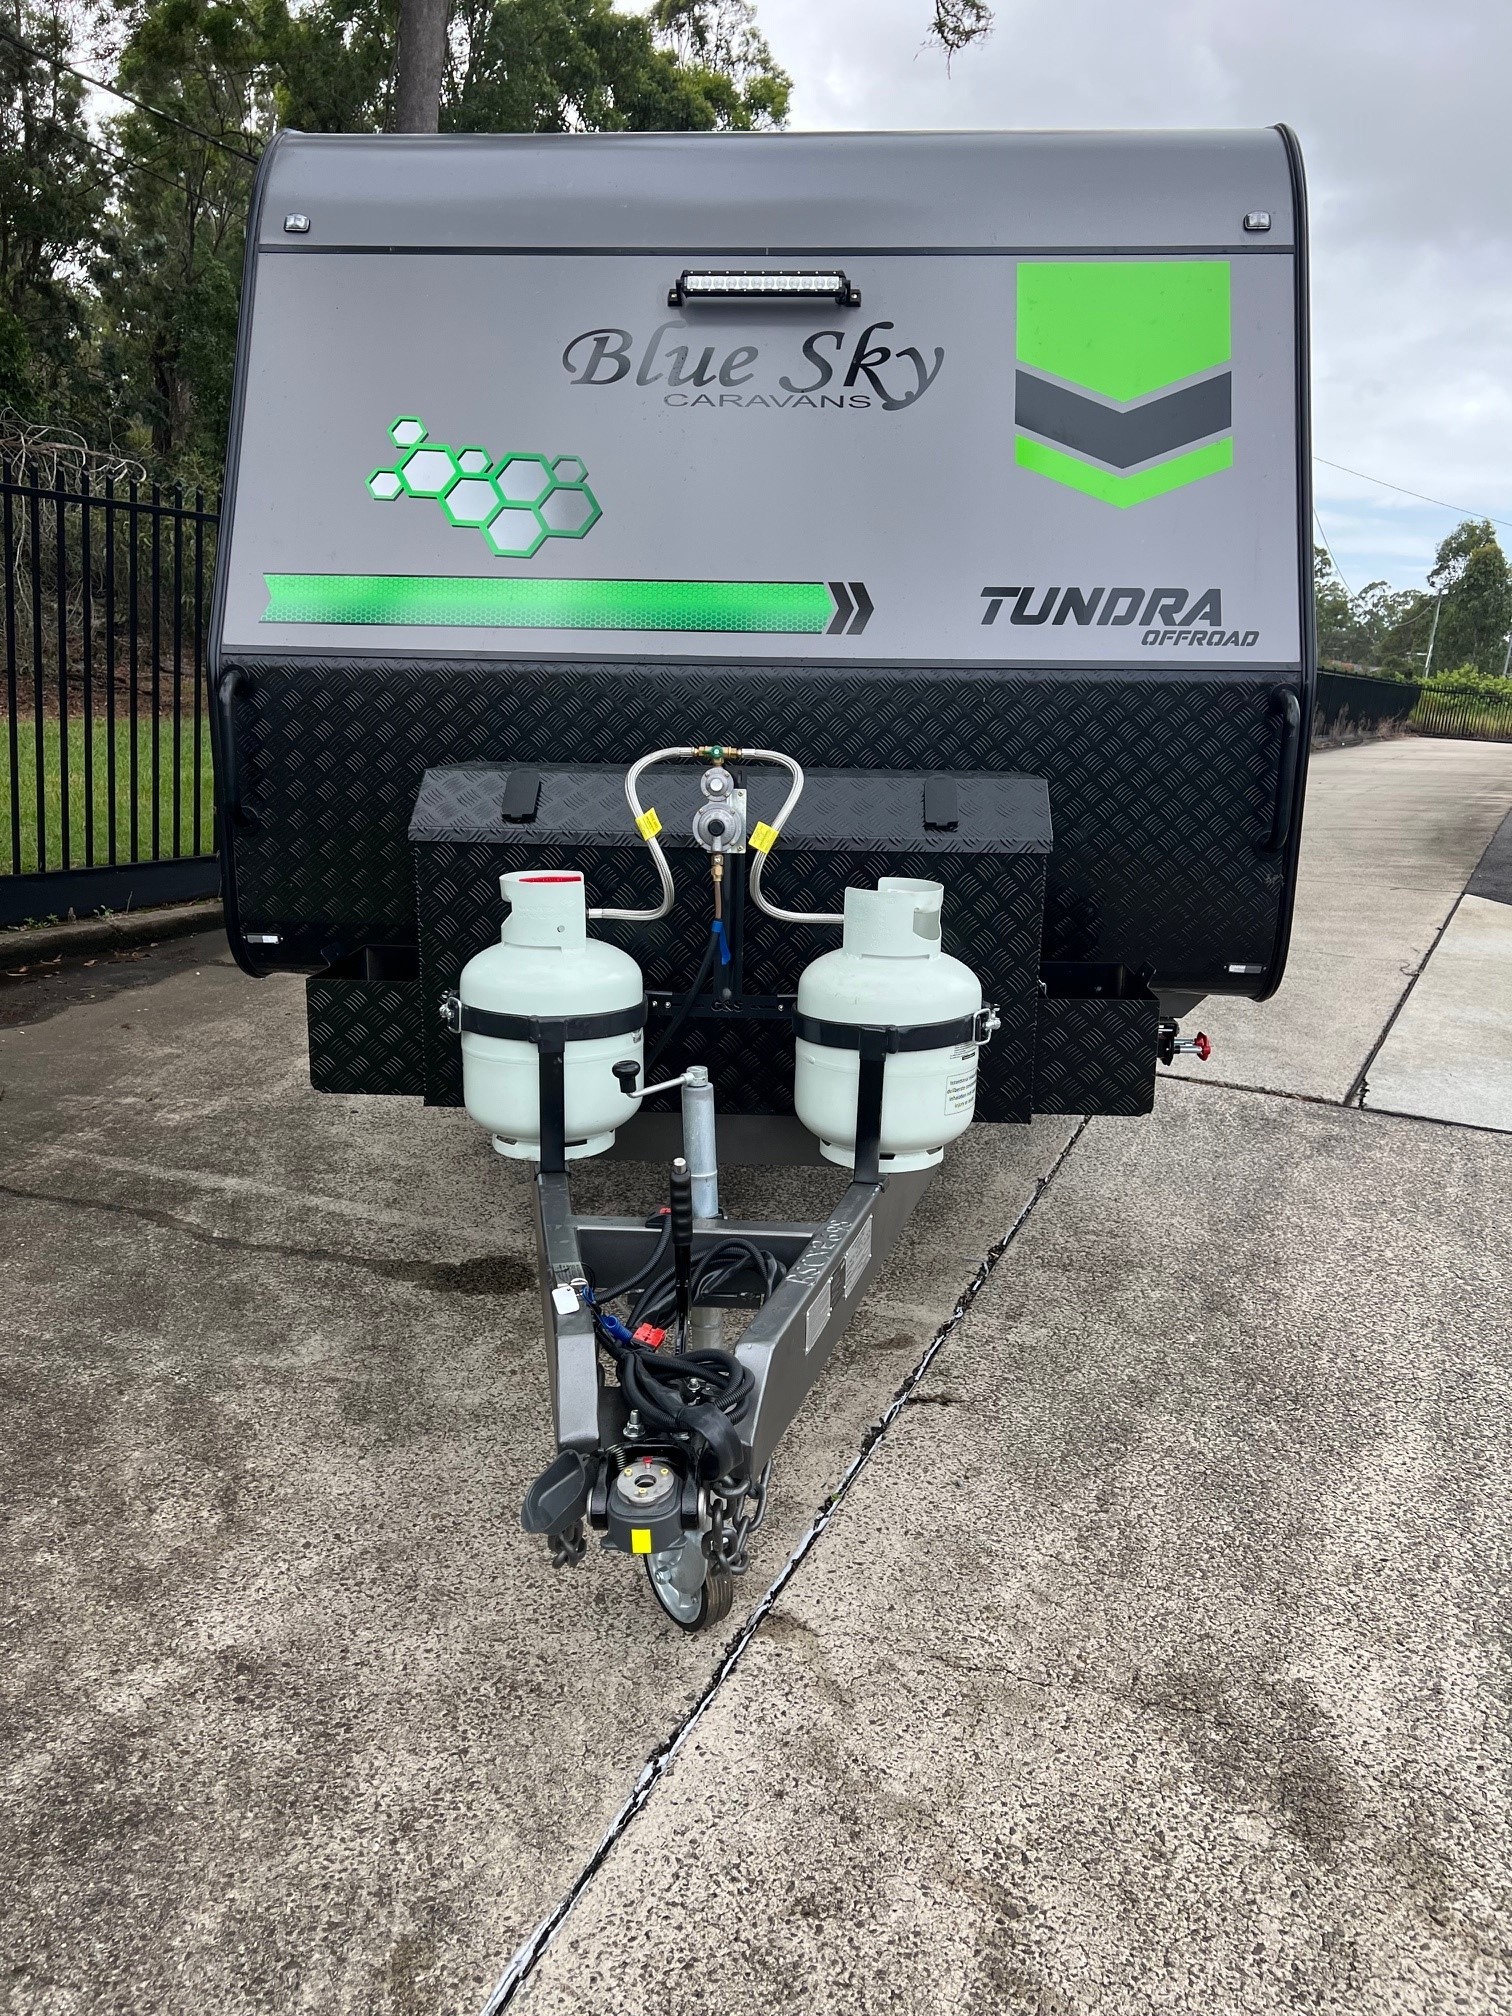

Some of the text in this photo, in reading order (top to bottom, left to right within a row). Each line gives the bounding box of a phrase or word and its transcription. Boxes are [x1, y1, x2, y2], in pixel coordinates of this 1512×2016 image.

[562, 320, 945, 411] Blue Sky
[663, 393, 872, 409] CARAVANS
[980, 586, 1222, 626] TUNDRA
[1141, 630, 1260, 647] OFFROAD
